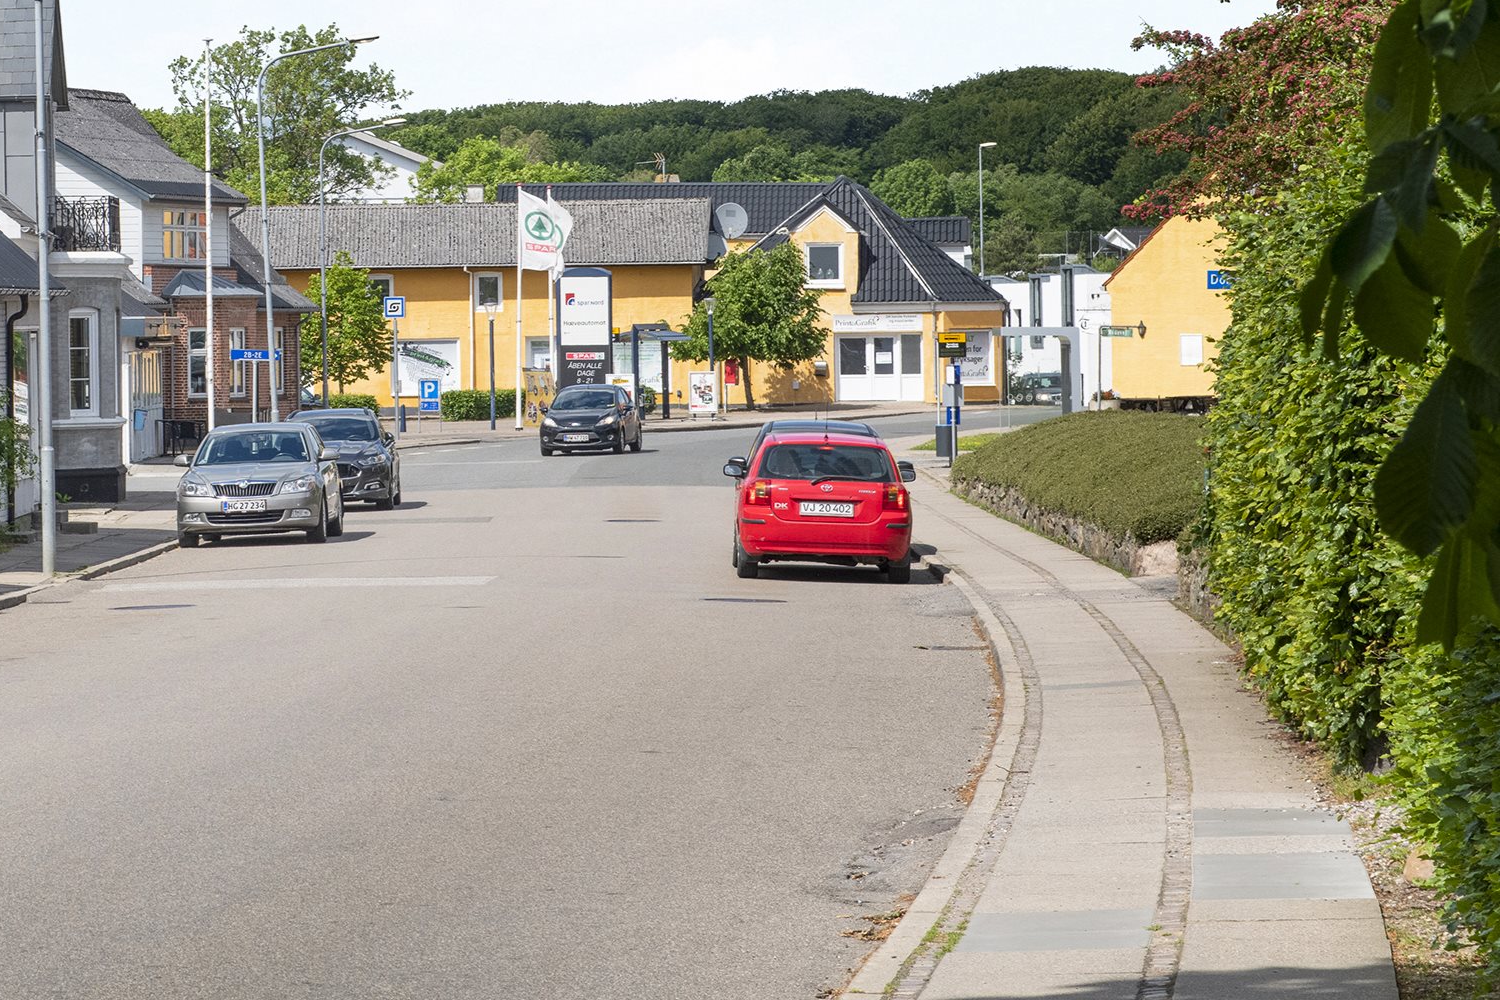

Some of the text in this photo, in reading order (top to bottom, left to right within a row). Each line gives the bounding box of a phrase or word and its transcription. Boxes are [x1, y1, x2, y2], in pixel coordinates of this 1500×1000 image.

[567, 361, 586, 369] ÅBEN
[424, 382, 436, 398] P
[239, 502, 249, 510] 27
[250, 501, 265, 509] 234
[774, 502, 788, 510] DK
[803, 503, 851, 513] VJ 20 402
